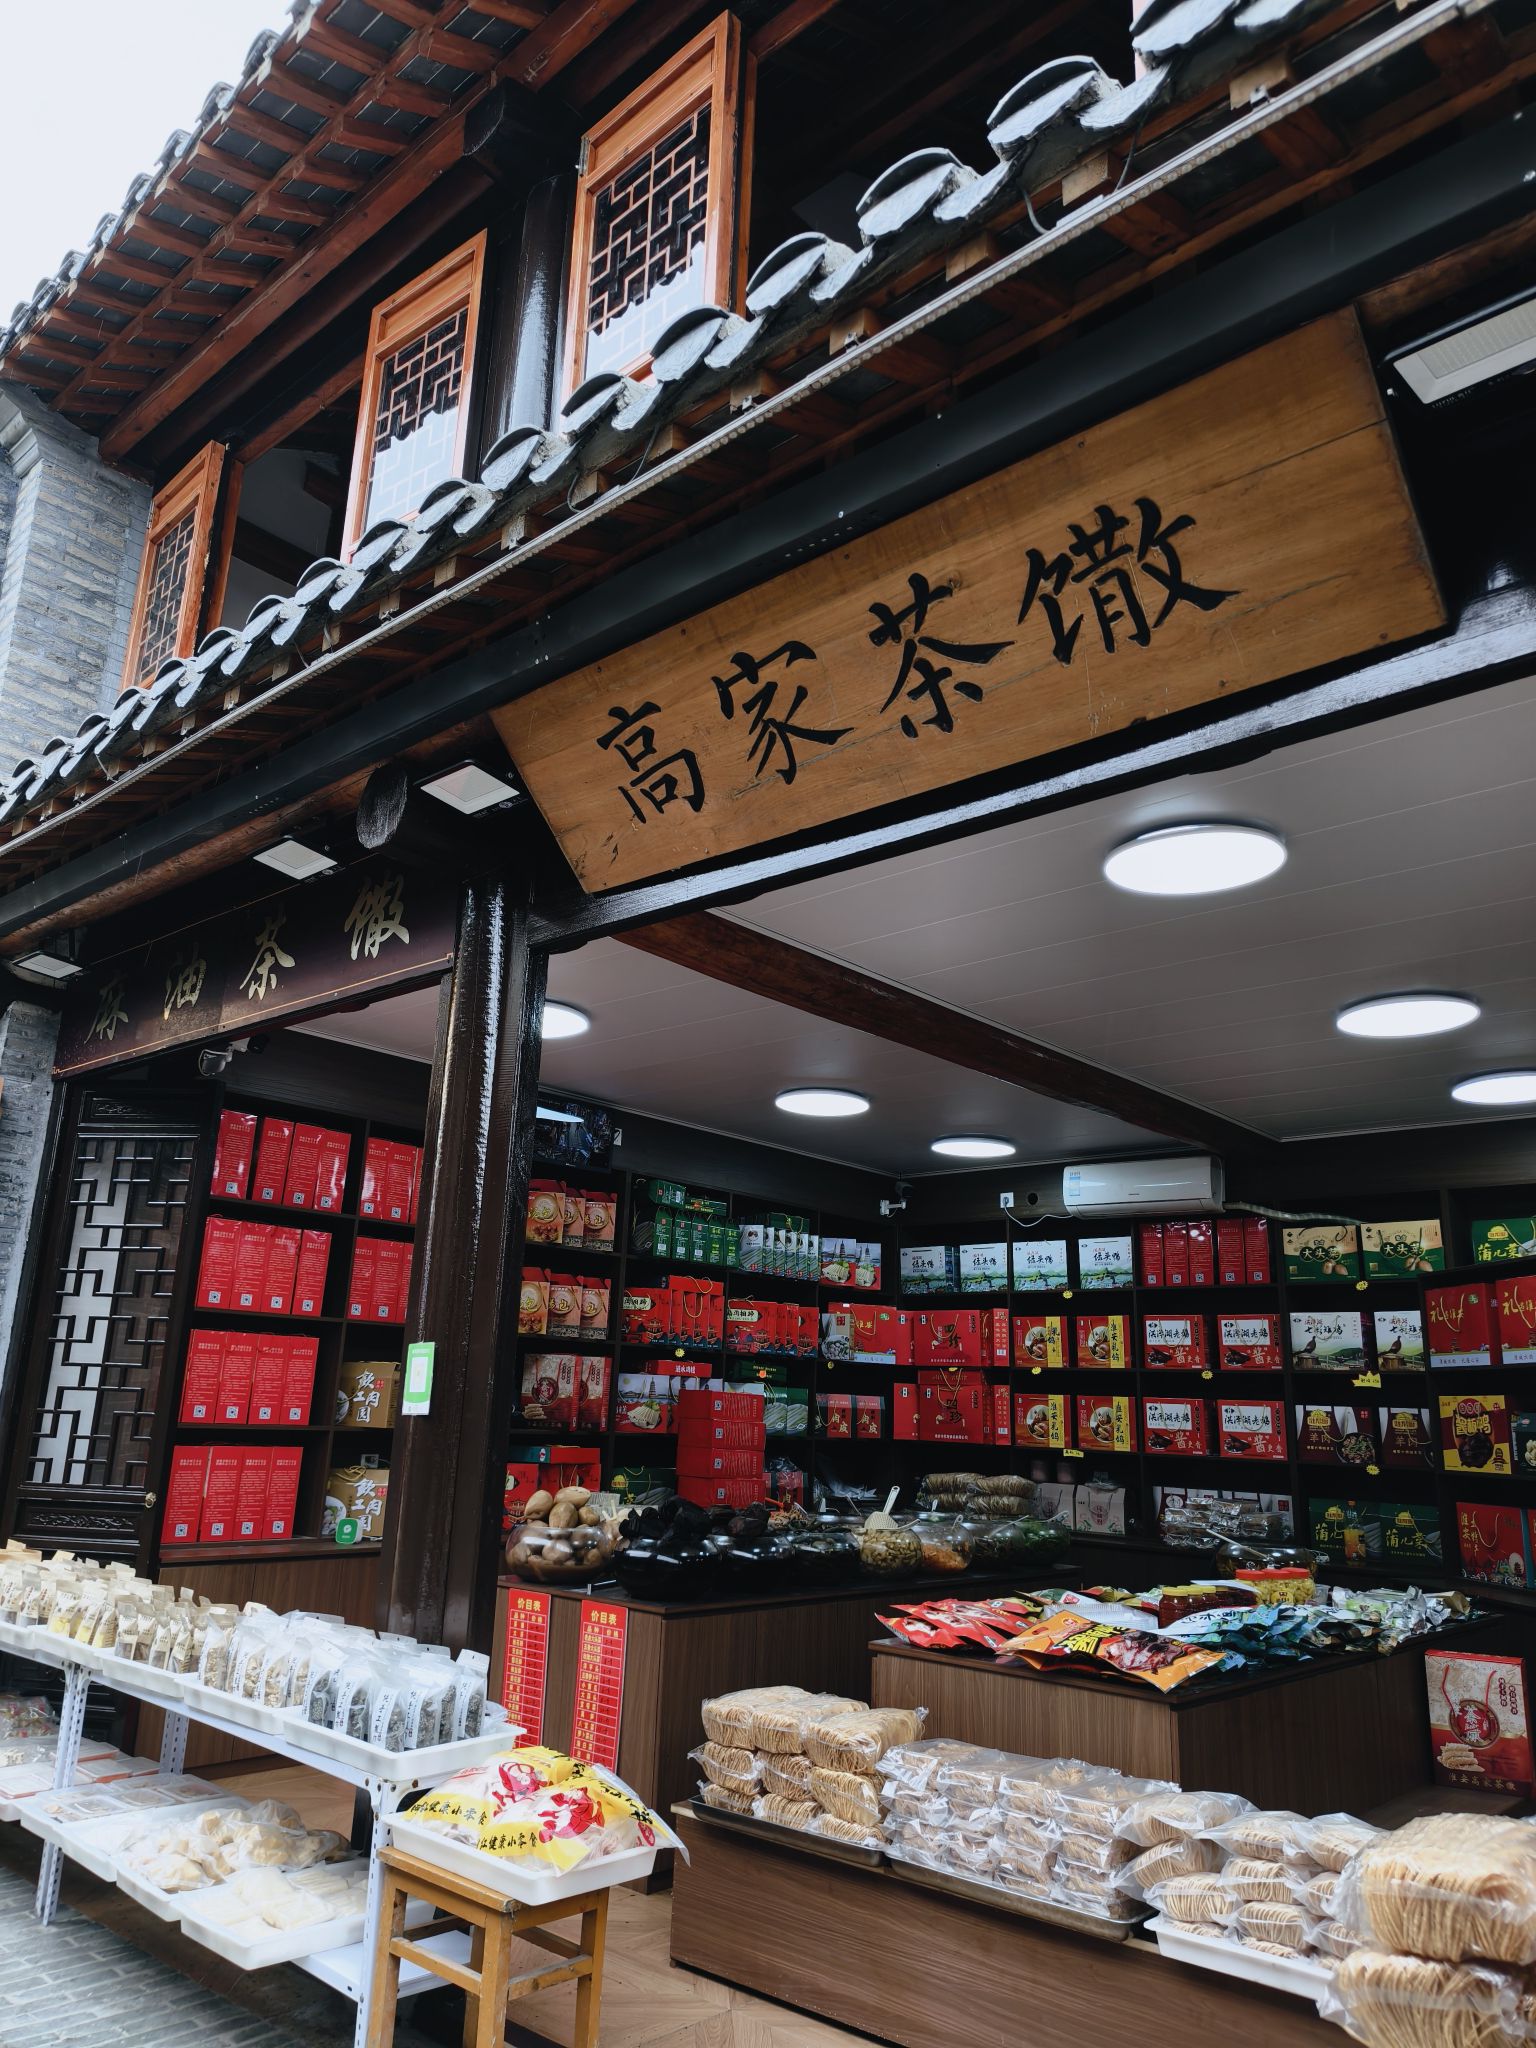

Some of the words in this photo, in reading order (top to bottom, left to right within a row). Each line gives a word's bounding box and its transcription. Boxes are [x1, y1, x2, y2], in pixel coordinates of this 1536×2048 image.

[596, 496, 1244, 825] 高家茶馓
[517, 1597, 541, 1612] 价目表
[590, 1609, 617, 1626] 价目表
